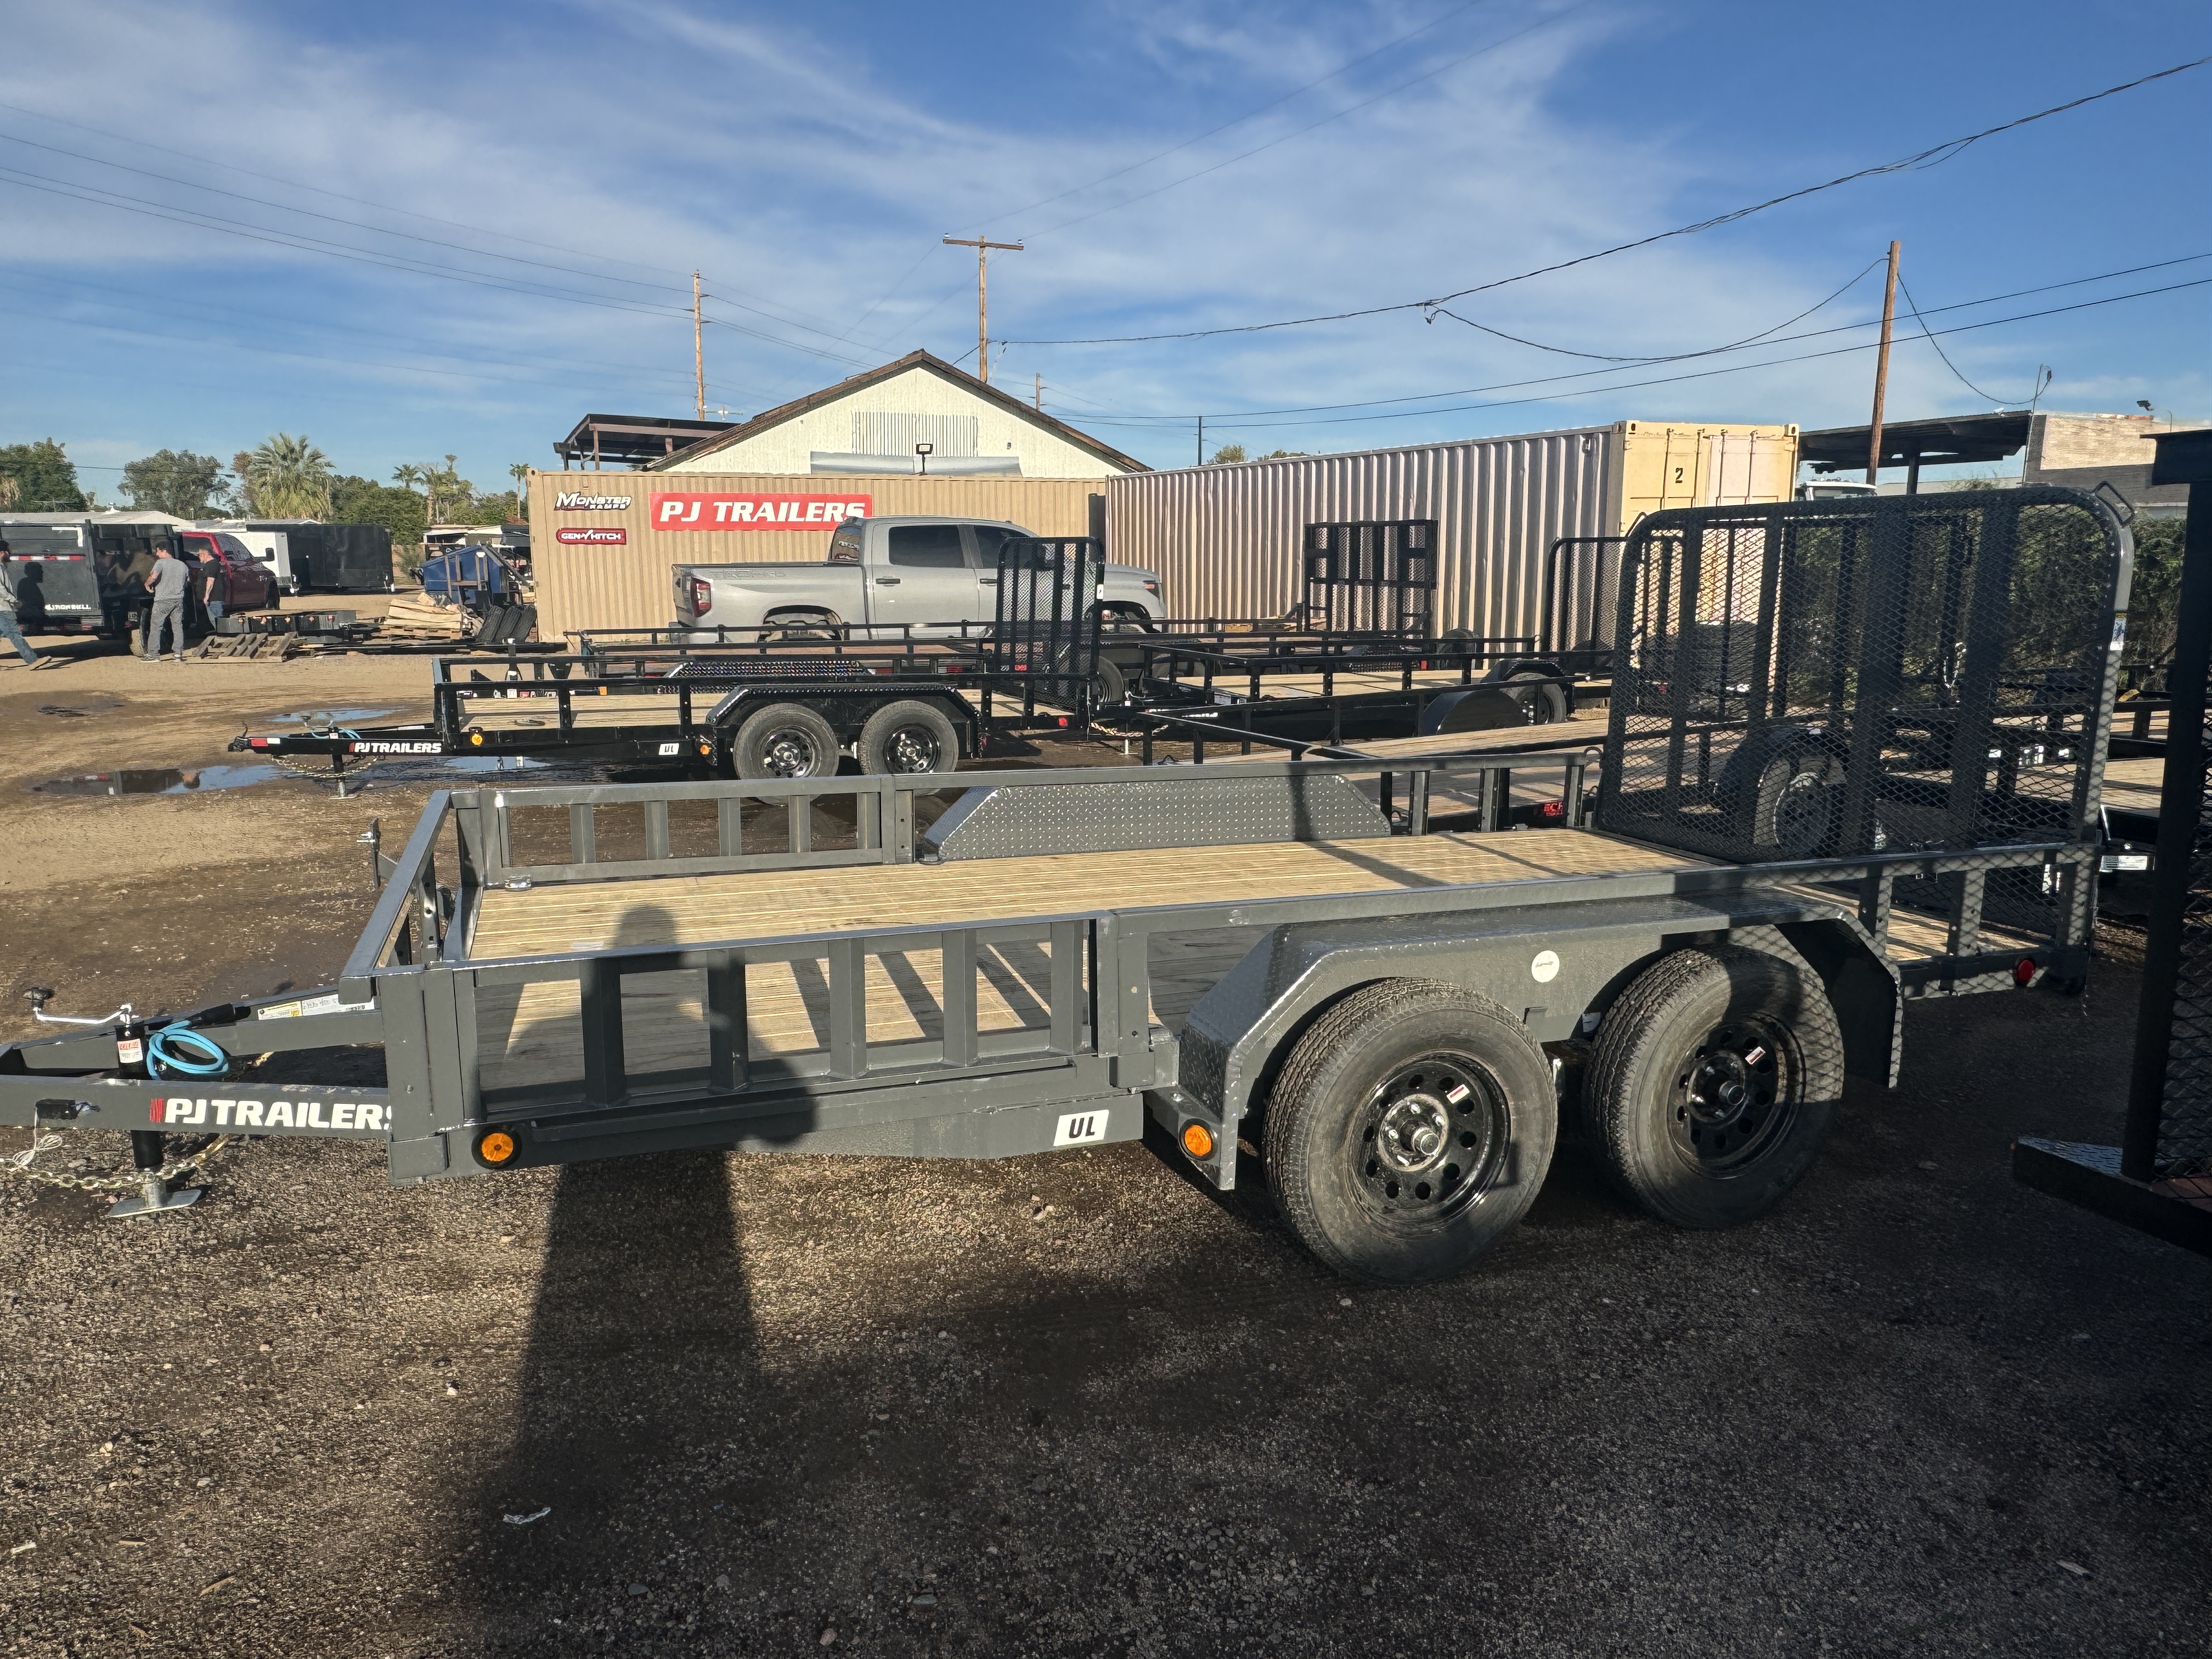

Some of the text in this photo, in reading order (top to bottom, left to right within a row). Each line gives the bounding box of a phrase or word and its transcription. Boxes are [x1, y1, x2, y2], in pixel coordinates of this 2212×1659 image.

[1675, 467, 1683, 483] 2
[660, 501, 865, 522] PJ TRAILERS
[354, 742, 442, 753] PJ TRAILERS
[165, 1098, 207, 1124] PJ
[1069, 1116, 1095, 1138] UL
